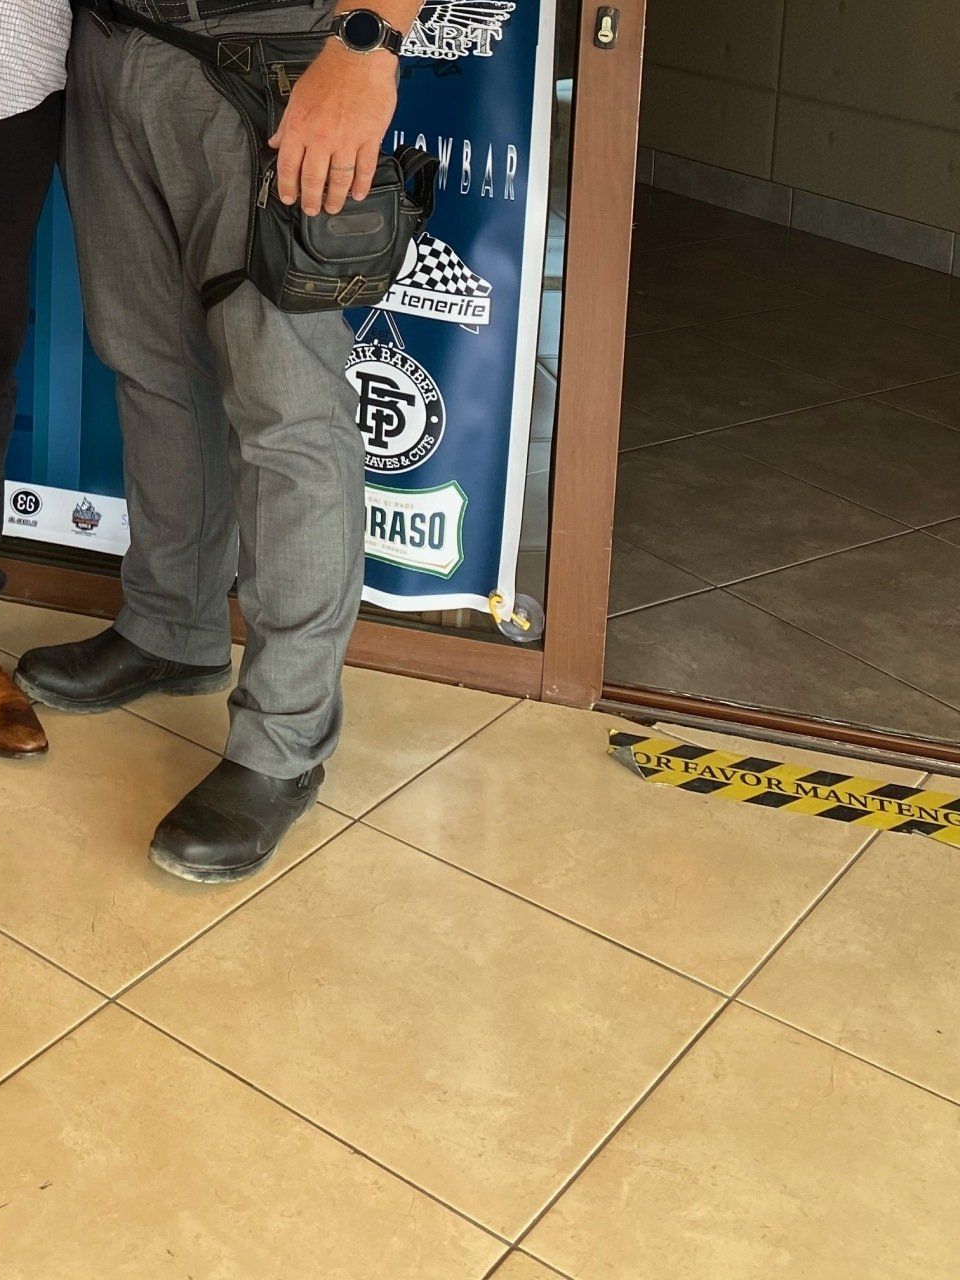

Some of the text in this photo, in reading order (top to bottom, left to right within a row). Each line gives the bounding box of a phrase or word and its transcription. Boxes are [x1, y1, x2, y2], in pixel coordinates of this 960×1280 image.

[401, 21, 503, 57] ART
[400, 287, 487, 319] tenerife
[379, 348, 438, 404] BARBER
[400, 454, 411, 467] &
[409, 434, 435, 461] CUTS
[365, 504, 446, 550] RASO
[633, 750, 960, 827] OR FAVOR MANTENG
